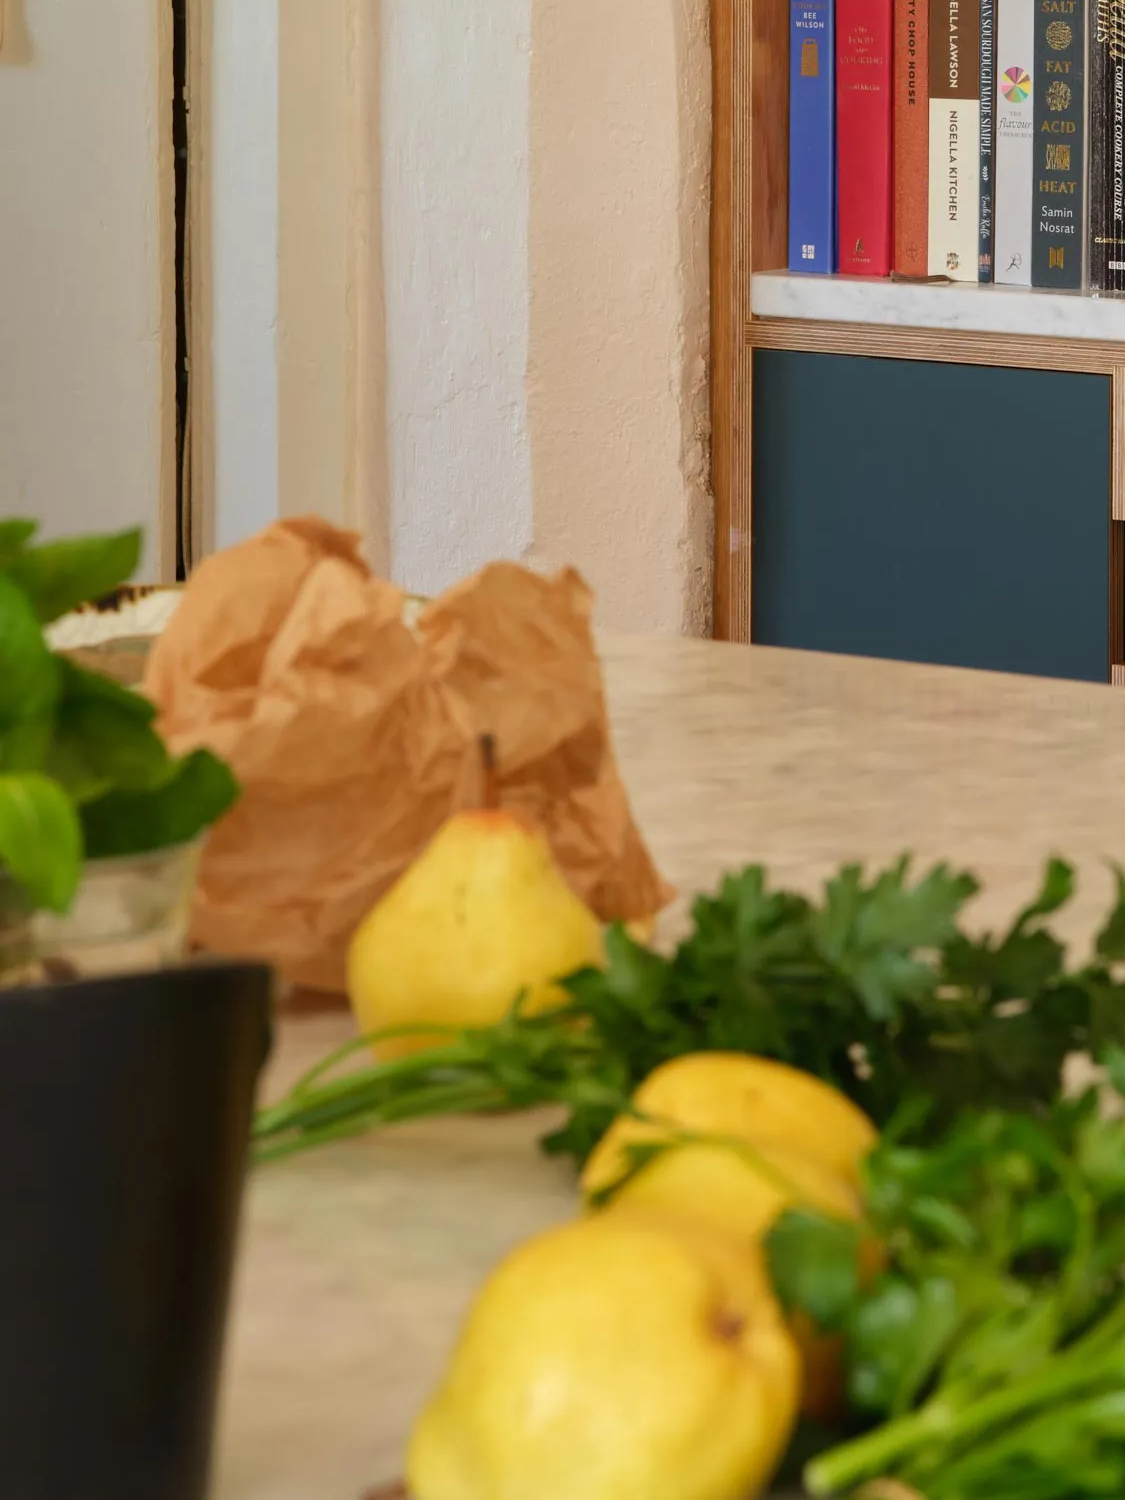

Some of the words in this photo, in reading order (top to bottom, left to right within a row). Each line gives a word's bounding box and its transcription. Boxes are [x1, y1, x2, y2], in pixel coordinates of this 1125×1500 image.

[1041, 1, 1076, 13] SALT
[949, 35, 958, 88] LAWSON
[981, 18, 992, 87] SOURDOUGH
[1046, 61, 1071, 73] FAT
[981, 88, 991, 117] MADE
[1114, 64, 1123, 124] COMPLETE
[949, 111, 958, 164] NIGELLA
[981, 118, 991, 156] SIMPLE
[999, 117, 1032, 130] flavour
[1041, 121, 1076, 133] ACID
[1114, 127, 1122, 174] COOKERY
[948, 167, 957, 221] KITCHEN
[1039, 181, 1076, 194] HEAT
[1113, 177, 1122, 221] COURSE
[1039, 221, 1075, 234] Nosrat
[1041, 206, 1073, 218] Samin
